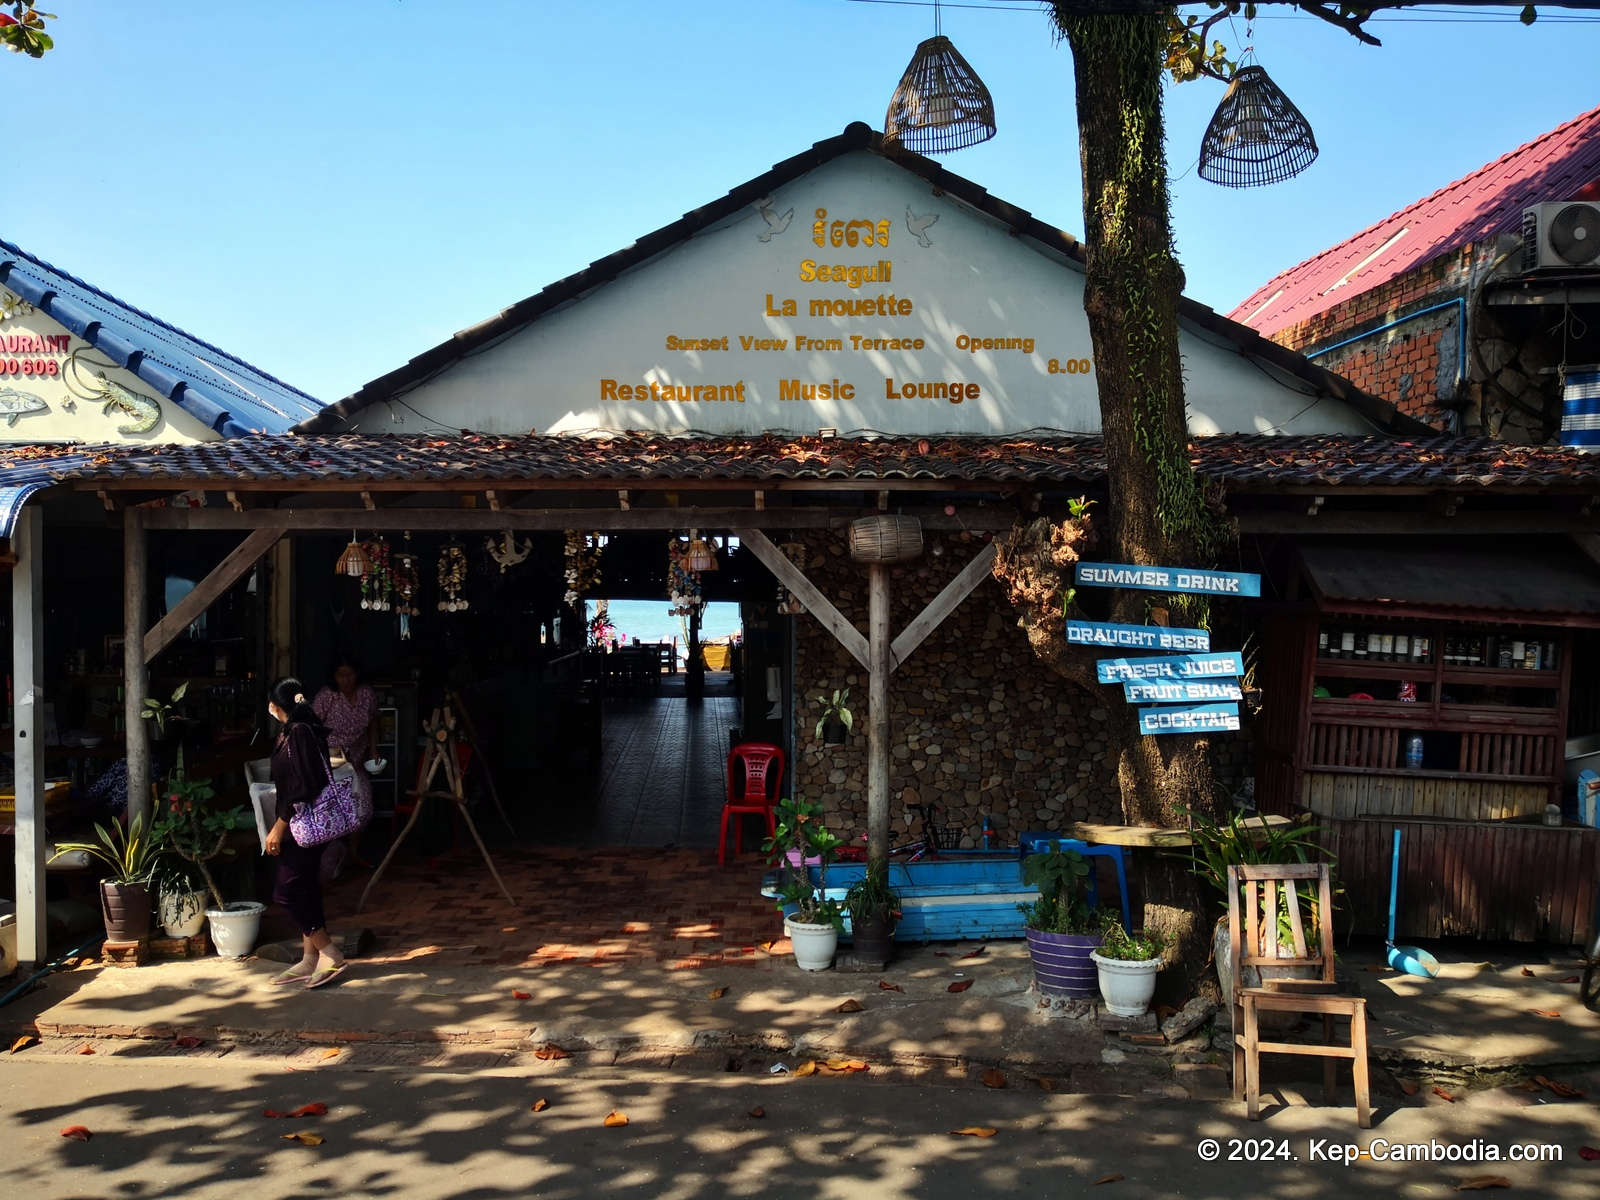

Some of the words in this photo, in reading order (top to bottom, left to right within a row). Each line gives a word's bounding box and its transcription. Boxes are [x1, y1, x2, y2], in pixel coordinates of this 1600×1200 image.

[799, 259, 892, 288] Seagull
[766, 294, 797, 317] La
[809, 295, 913, 317] mouette
[666, 335, 729, 351] Sunset
[740, 336, 787, 351] View
[796, 336, 842, 351] From
[850, 336, 924, 351] Terrace
[955, 334, 1035, 354] Opening
[22, 358, 59, 376] 606
[600, 379, 746, 403] Restaurant
[779, 379, 855, 401] Music
[885, 379, 981, 404] Lounge
[1080, 567, 1169, 586] SUMMER
[1177, 574, 1239, 592] DRINK
[1067, 627, 1155, 646] DRAUGHT
[1159, 634, 1210, 650] BEER
[1105, 663, 1173, 680] FRESH
[1179, 659, 1236, 676] JUICE
[1128, 685, 1184, 699] FRUIT
